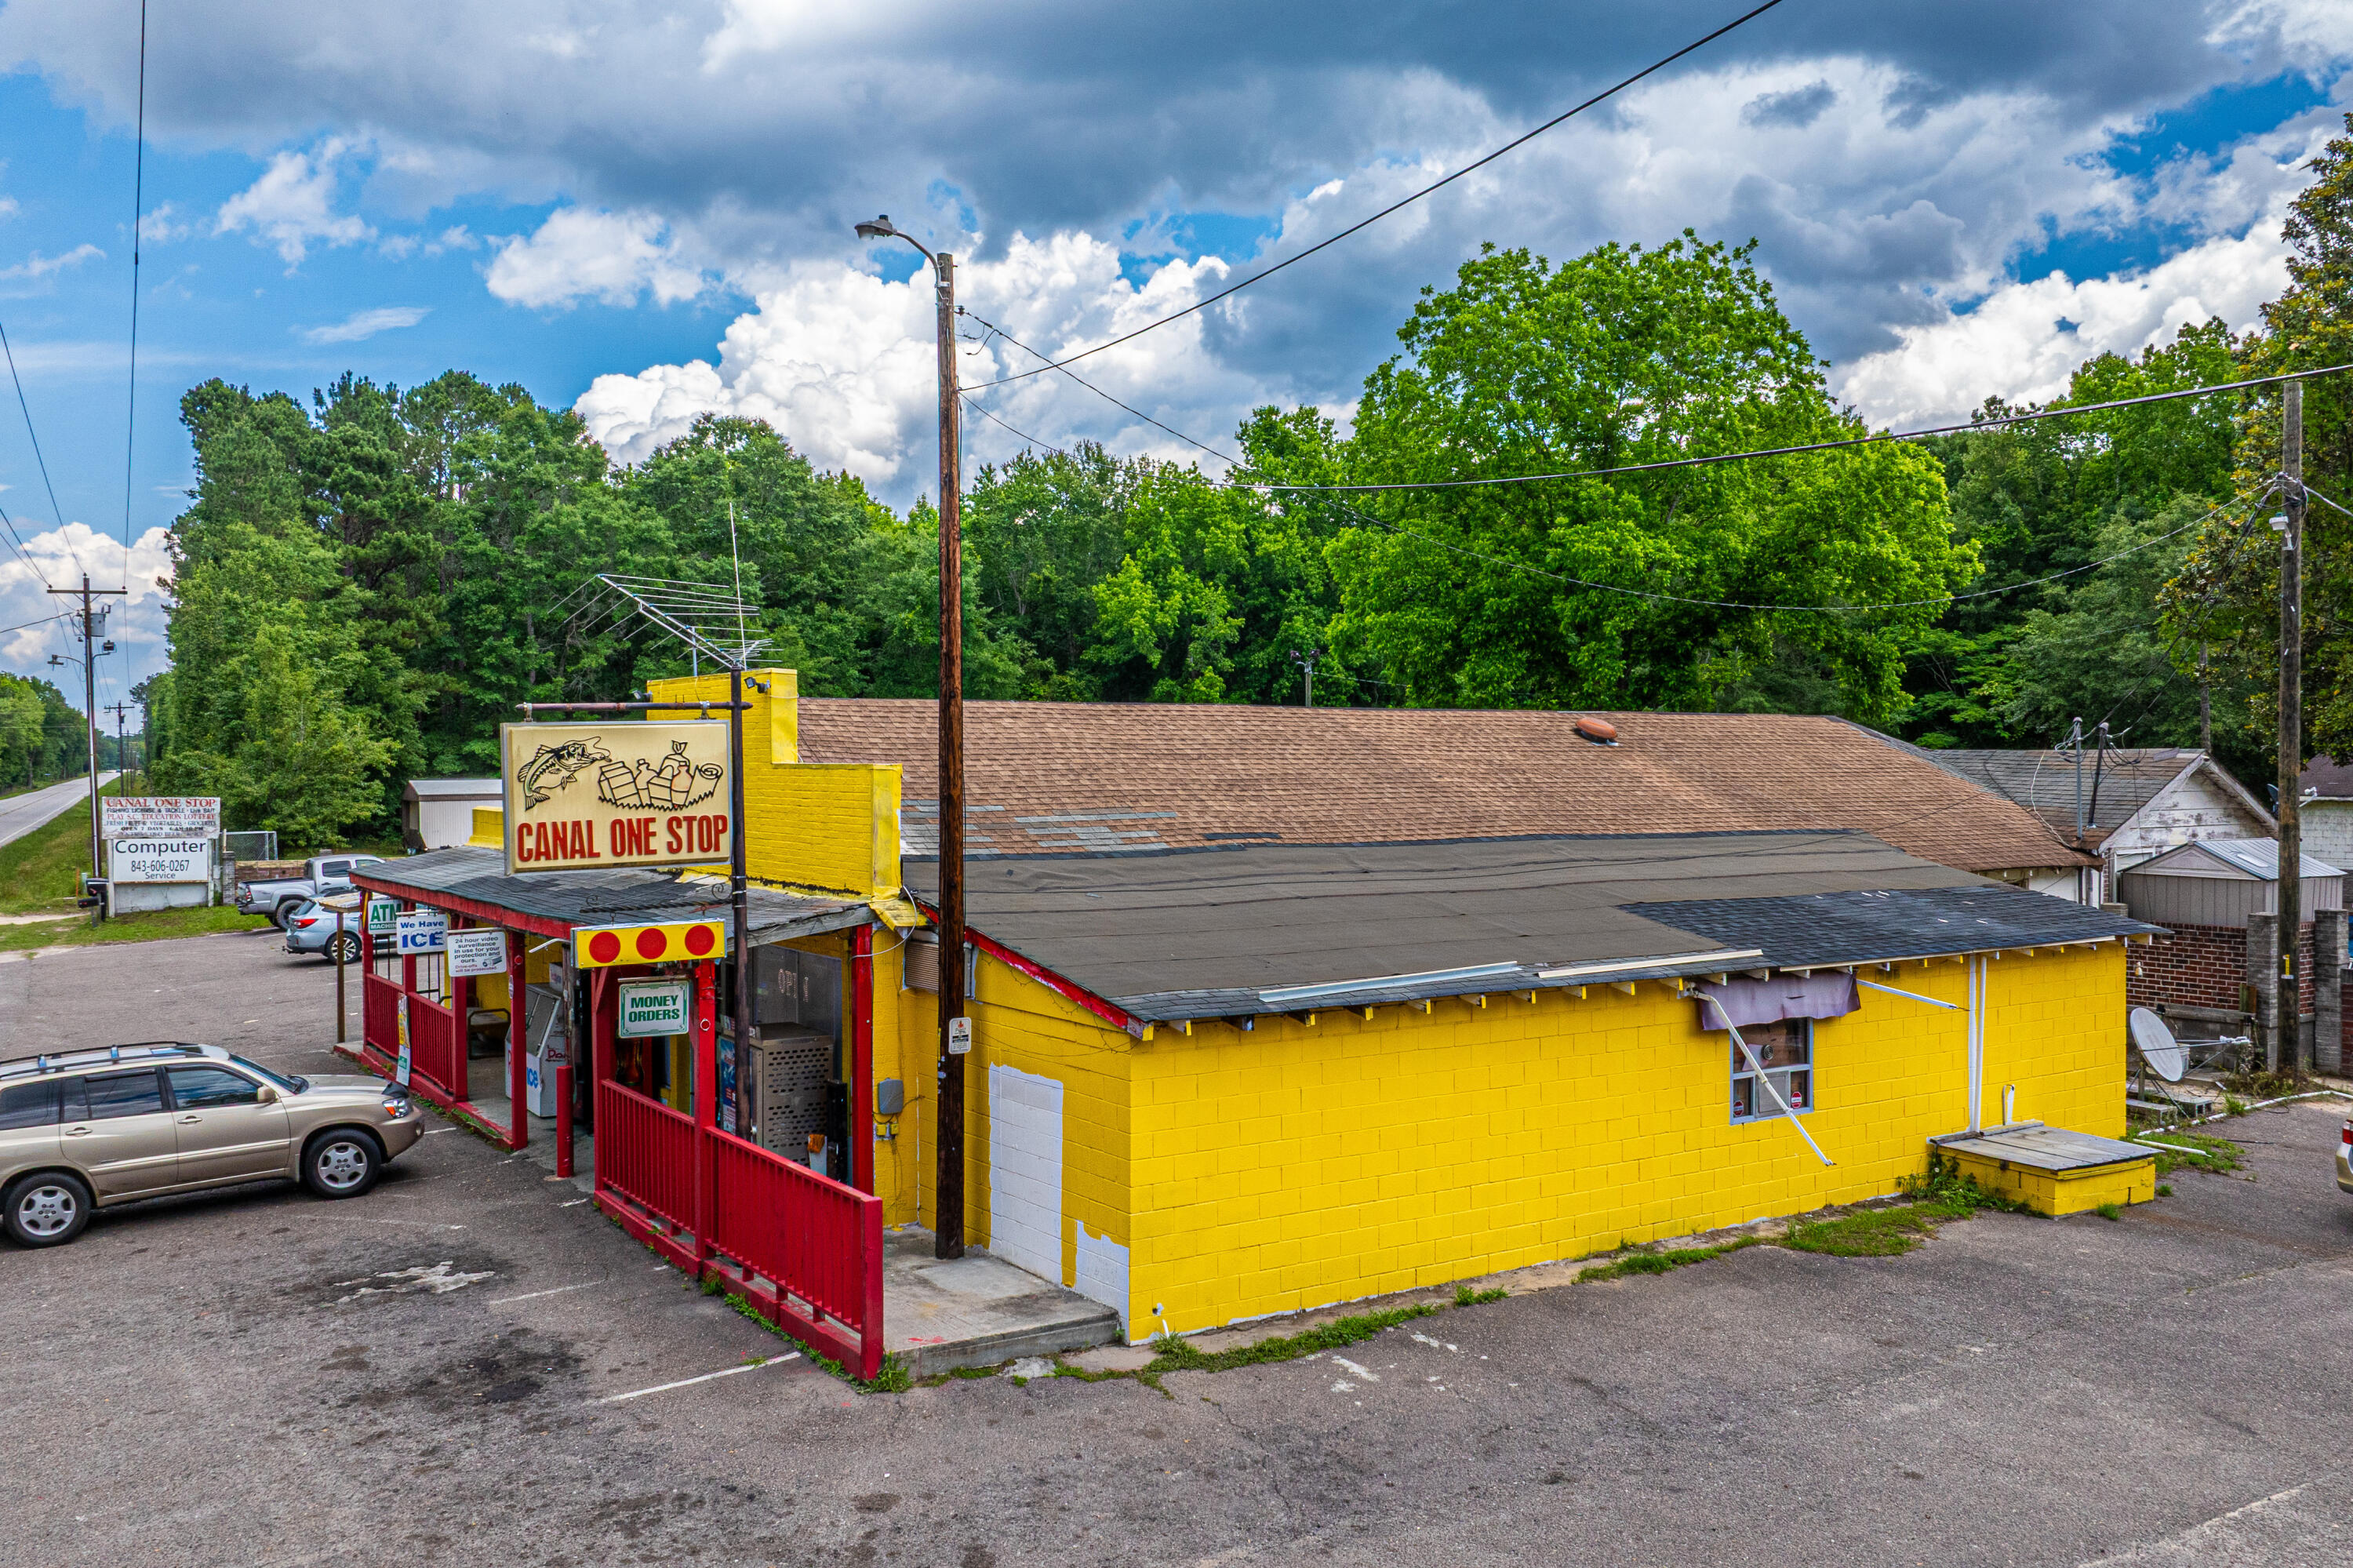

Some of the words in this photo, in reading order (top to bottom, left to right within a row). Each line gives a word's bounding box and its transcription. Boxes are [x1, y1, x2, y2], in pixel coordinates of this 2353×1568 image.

[106, 798, 151, 807] CANAL
[155, 798, 181, 807] ONE
[185, 799, 216, 807] STOP
[518, 819, 601, 862] CANAL
[610, 817, 657, 857] ONE
[667, 814, 728, 854] STOP
[115, 840, 206, 857] Computer
[131, 860, 190, 872] 843-606-0267
[370, 903, 402, 922] ATM
[402, 930, 444, 948] ICE
[631, 995, 678, 1008] MONEY
[628, 1008, 680, 1023] ORDERS
